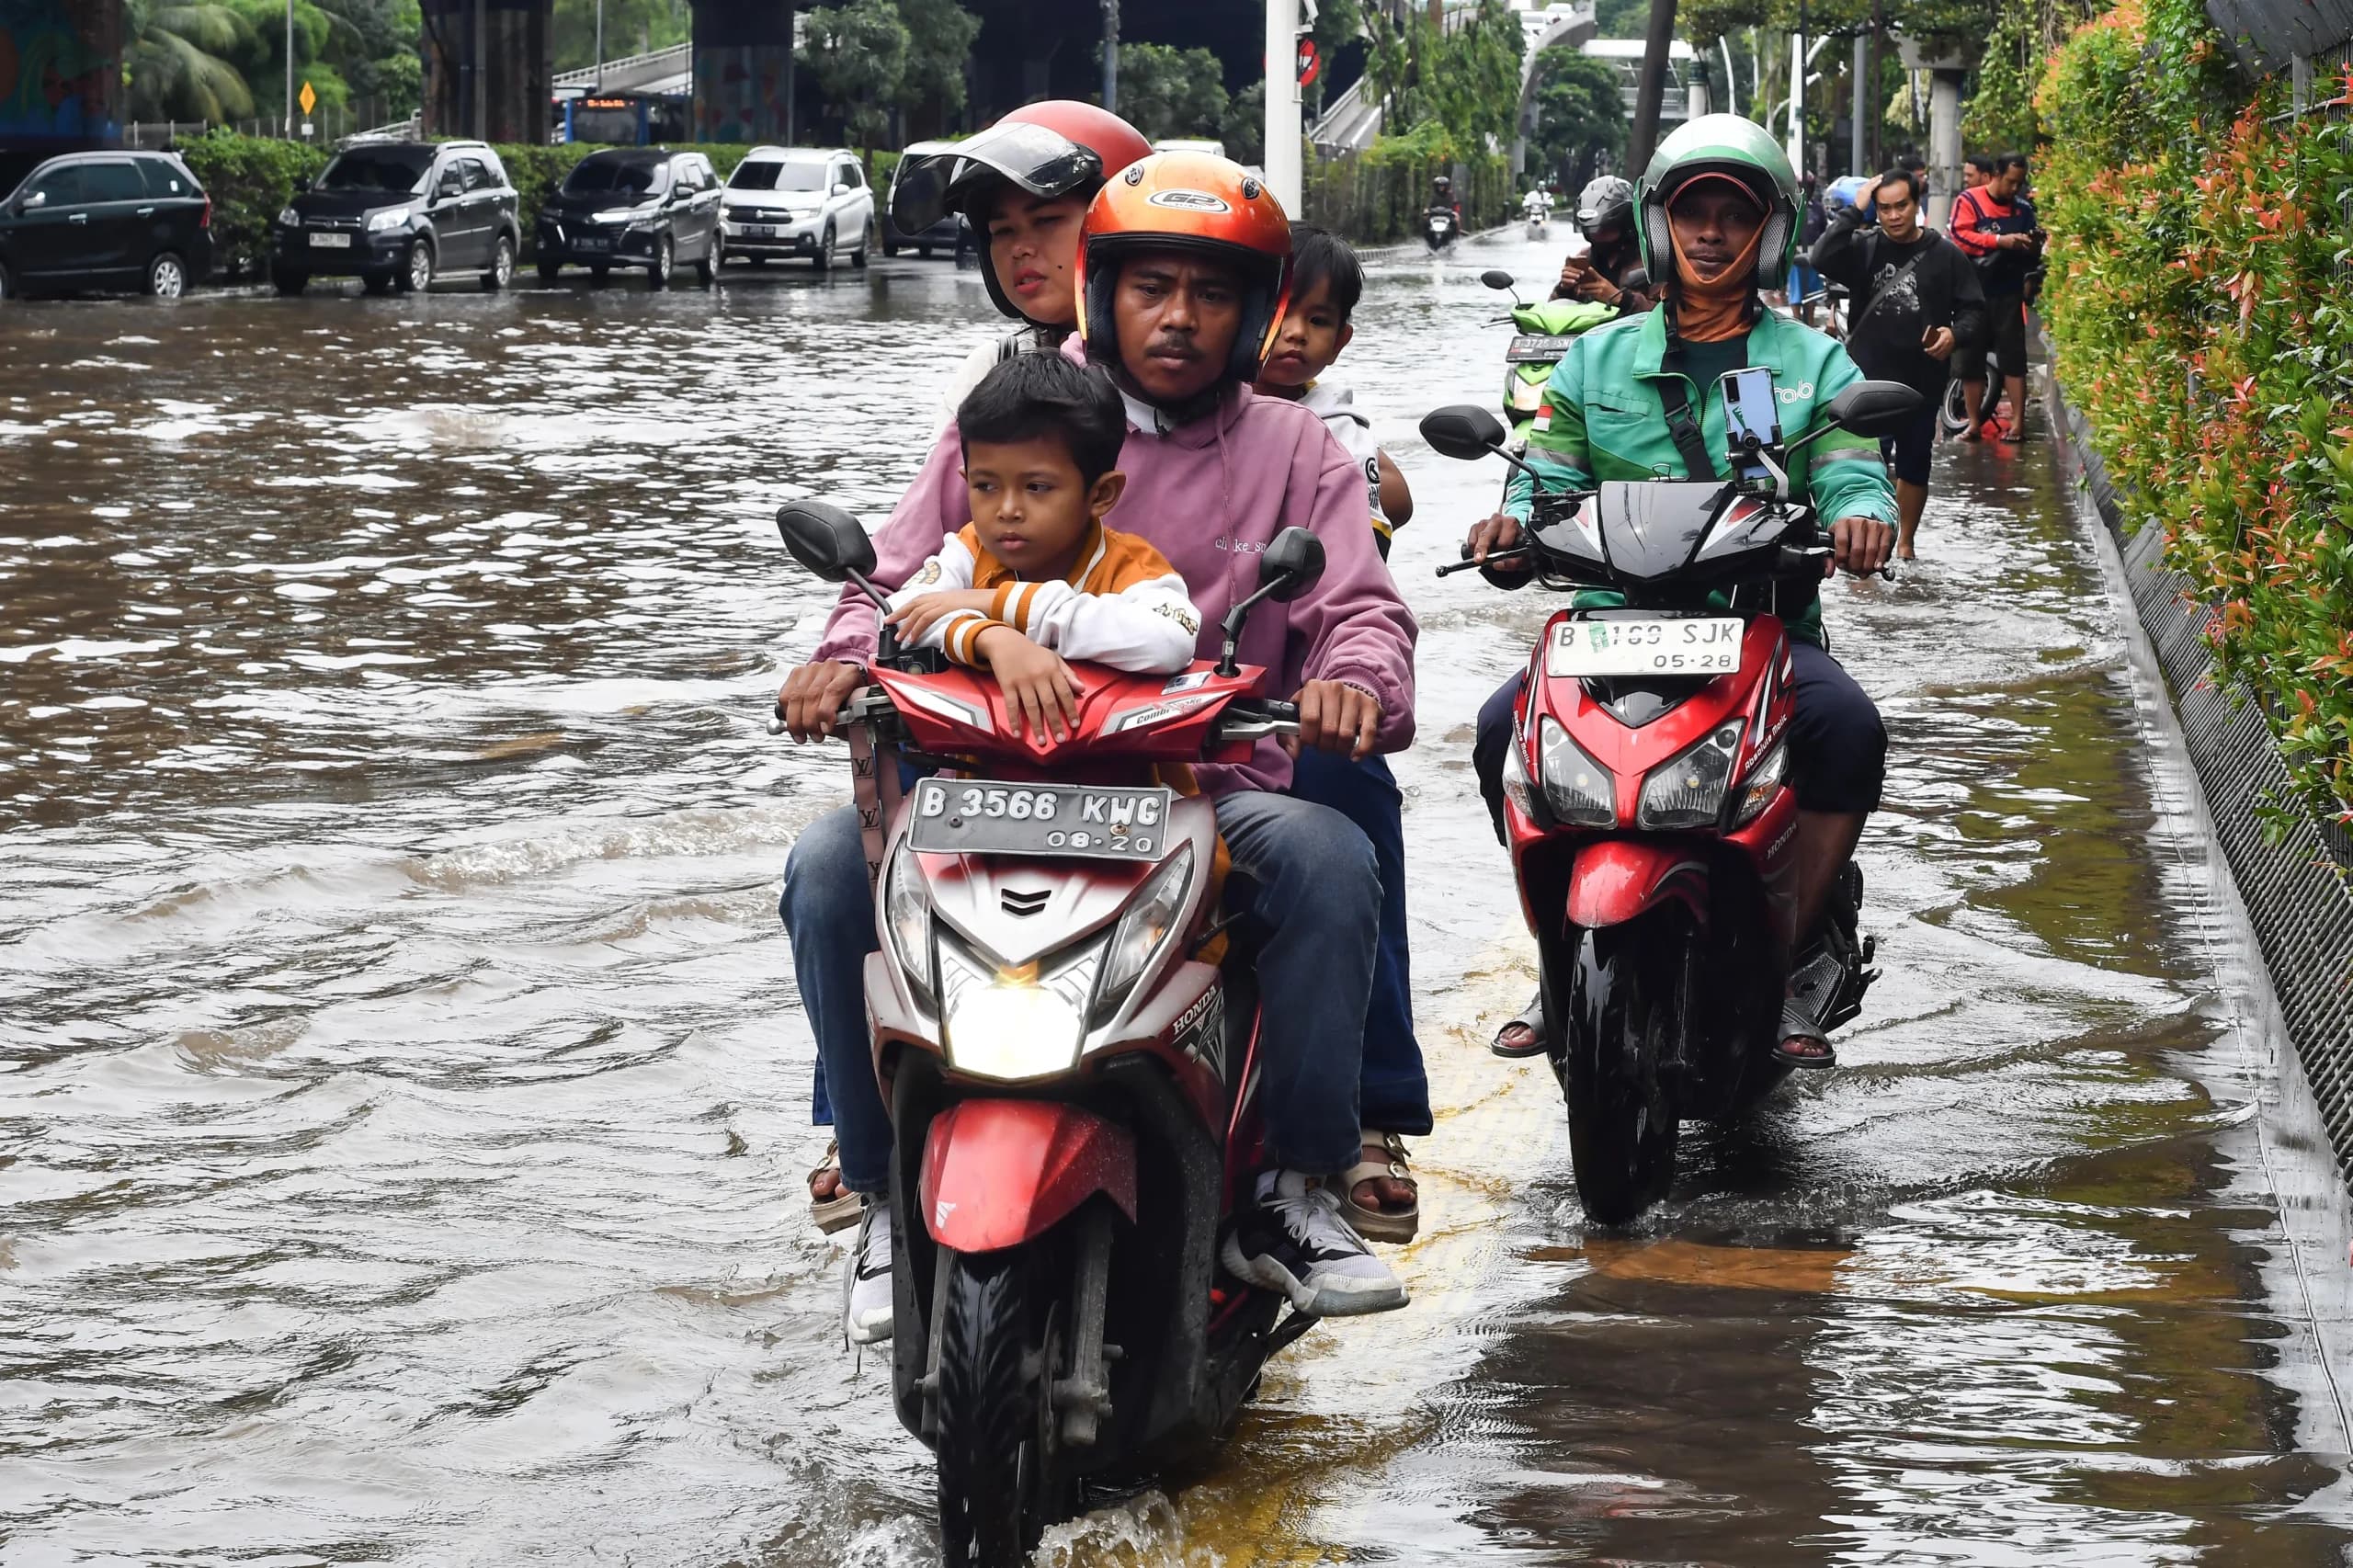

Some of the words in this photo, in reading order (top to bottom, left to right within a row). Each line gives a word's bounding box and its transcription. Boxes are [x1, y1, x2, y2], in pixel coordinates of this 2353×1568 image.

[1772, 377, 1814, 404] rab
[1559, 626, 1575, 647] B
[1682, 623, 1736, 644] SJK
[1745, 733, 1772, 772] Absolute
[921, 786, 947, 817] B
[959, 787, 1058, 821] 3566
[1081, 794, 1161, 826] KWG
[1172, 984, 1217, 1036] HONDA
